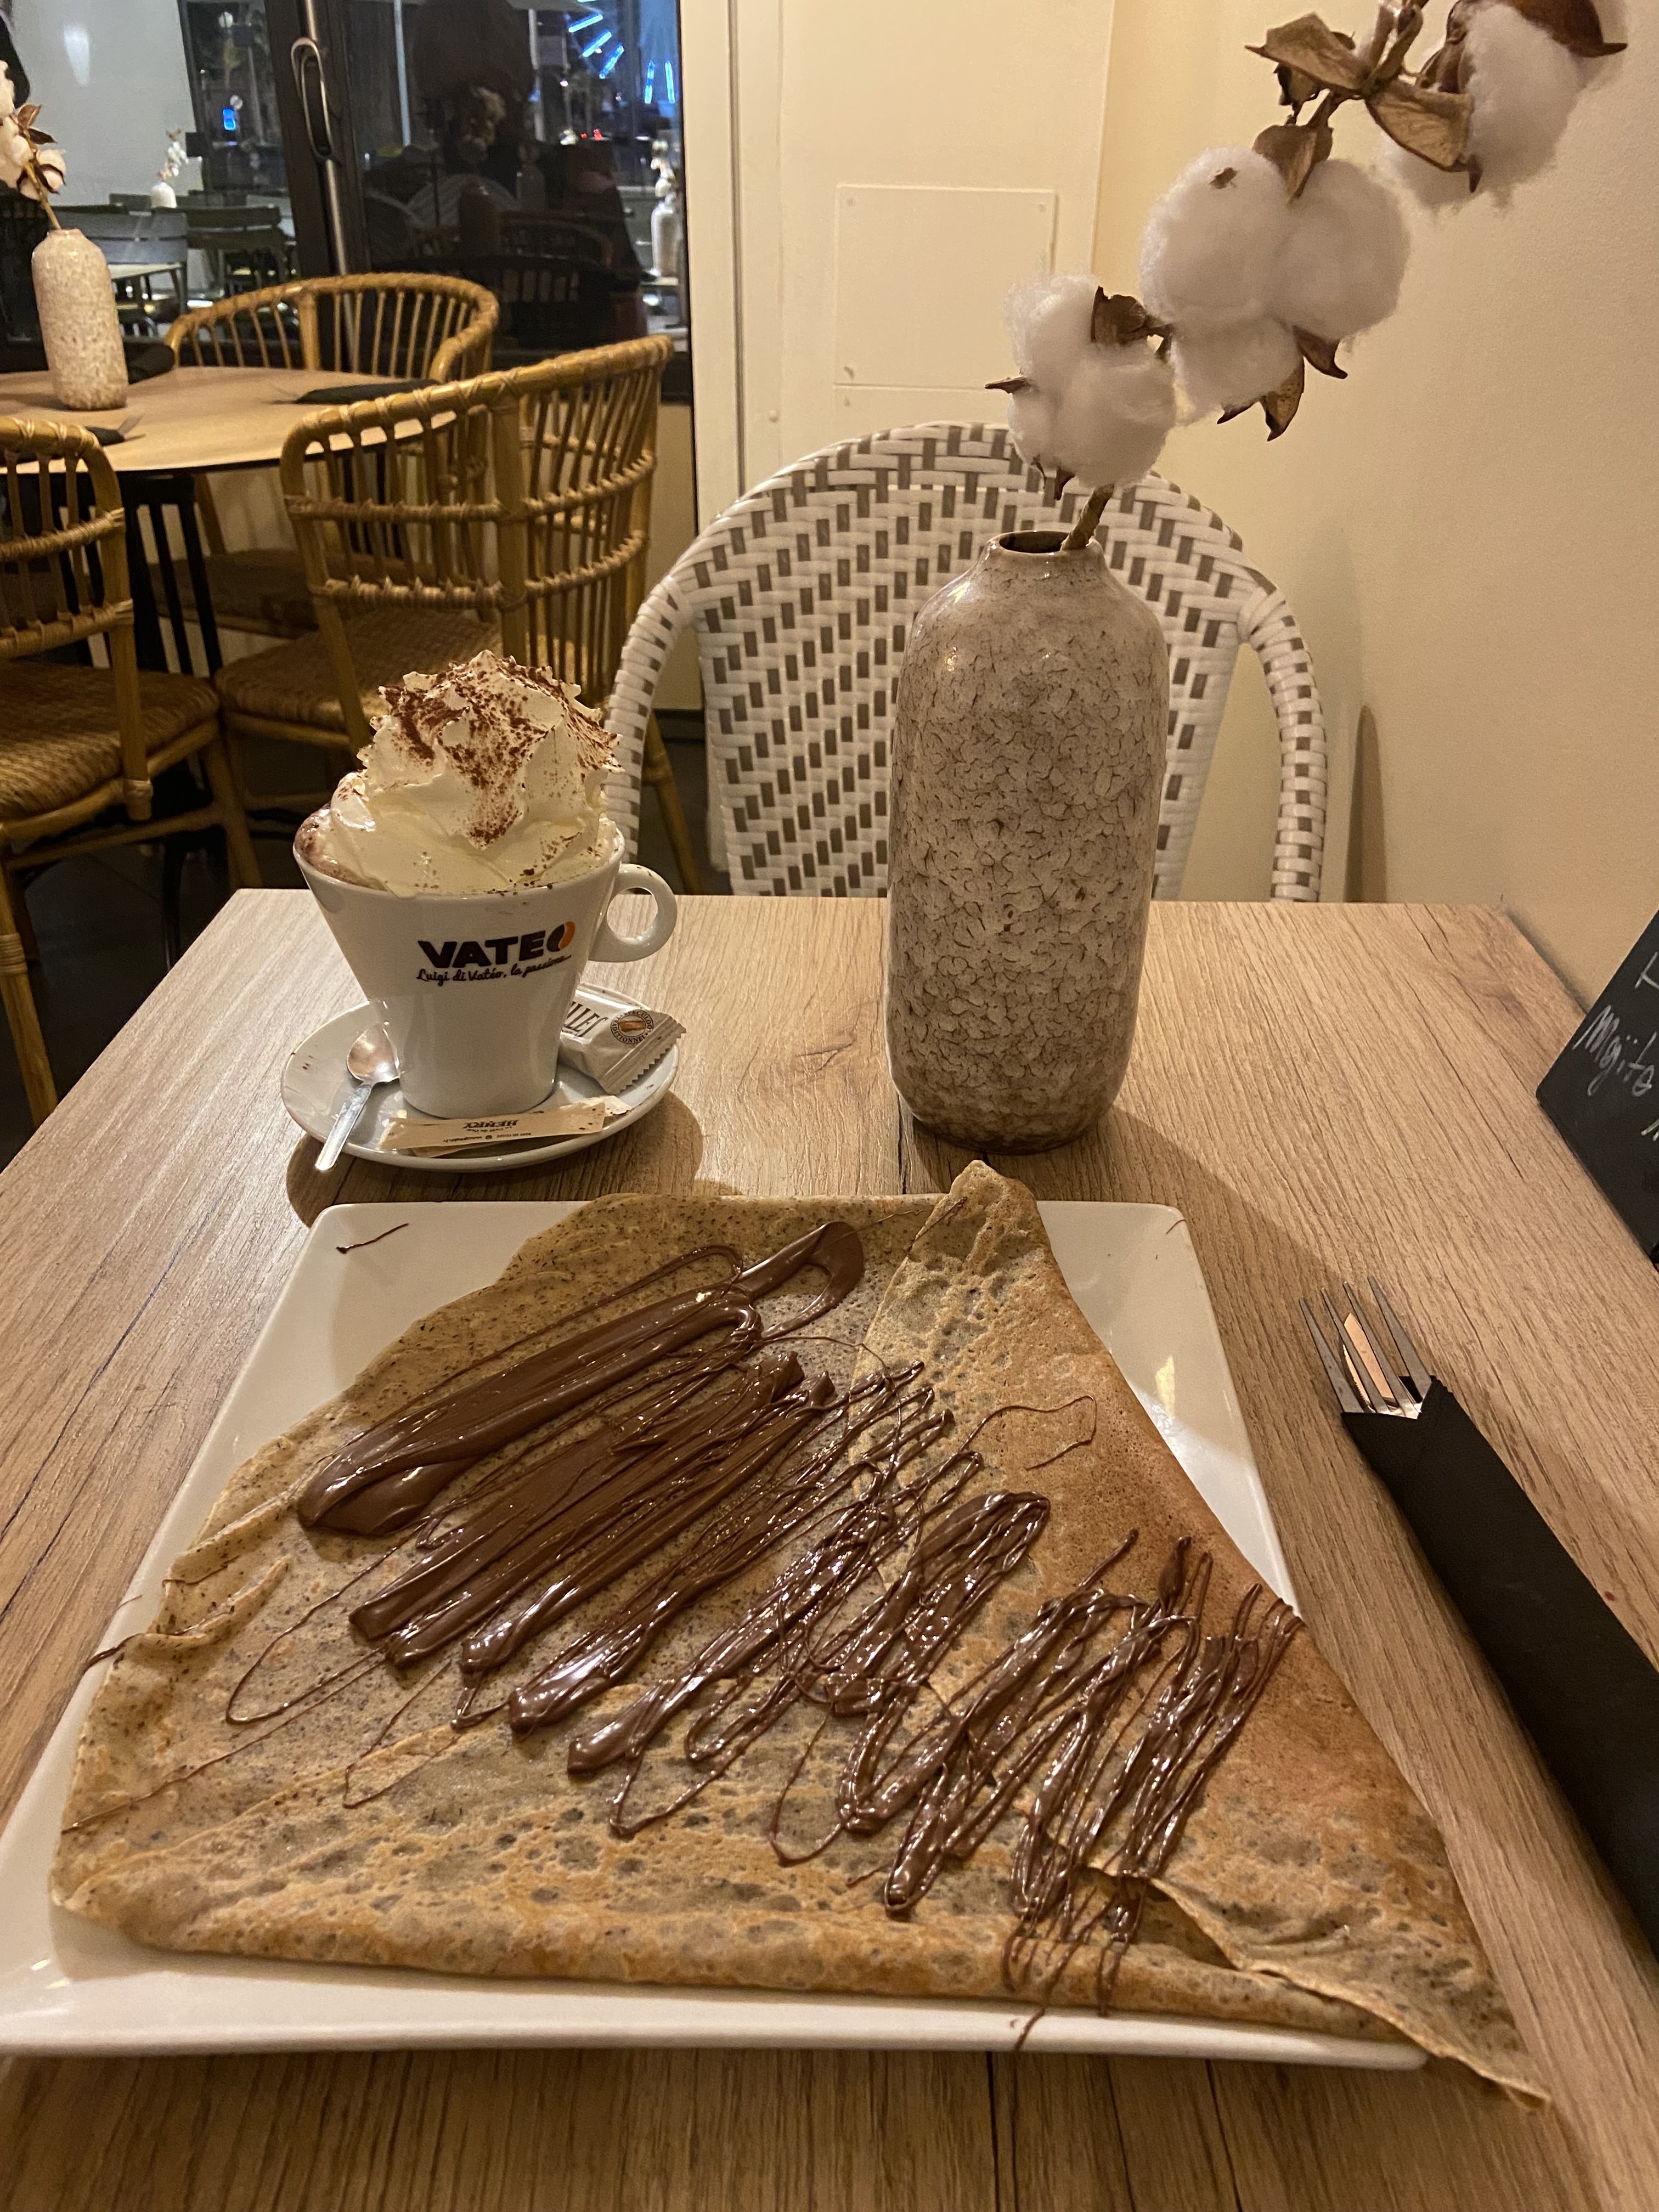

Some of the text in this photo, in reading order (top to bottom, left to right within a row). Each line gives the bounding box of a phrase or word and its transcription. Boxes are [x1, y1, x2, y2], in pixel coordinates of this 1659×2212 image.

[416, 968, 449, 986] Luigi
[453, 970, 466, 981] di
[468, 968, 507, 981] Vatéo,
[511, 963, 522, 975] la
[462, 1120, 519, 1129] HENRY
